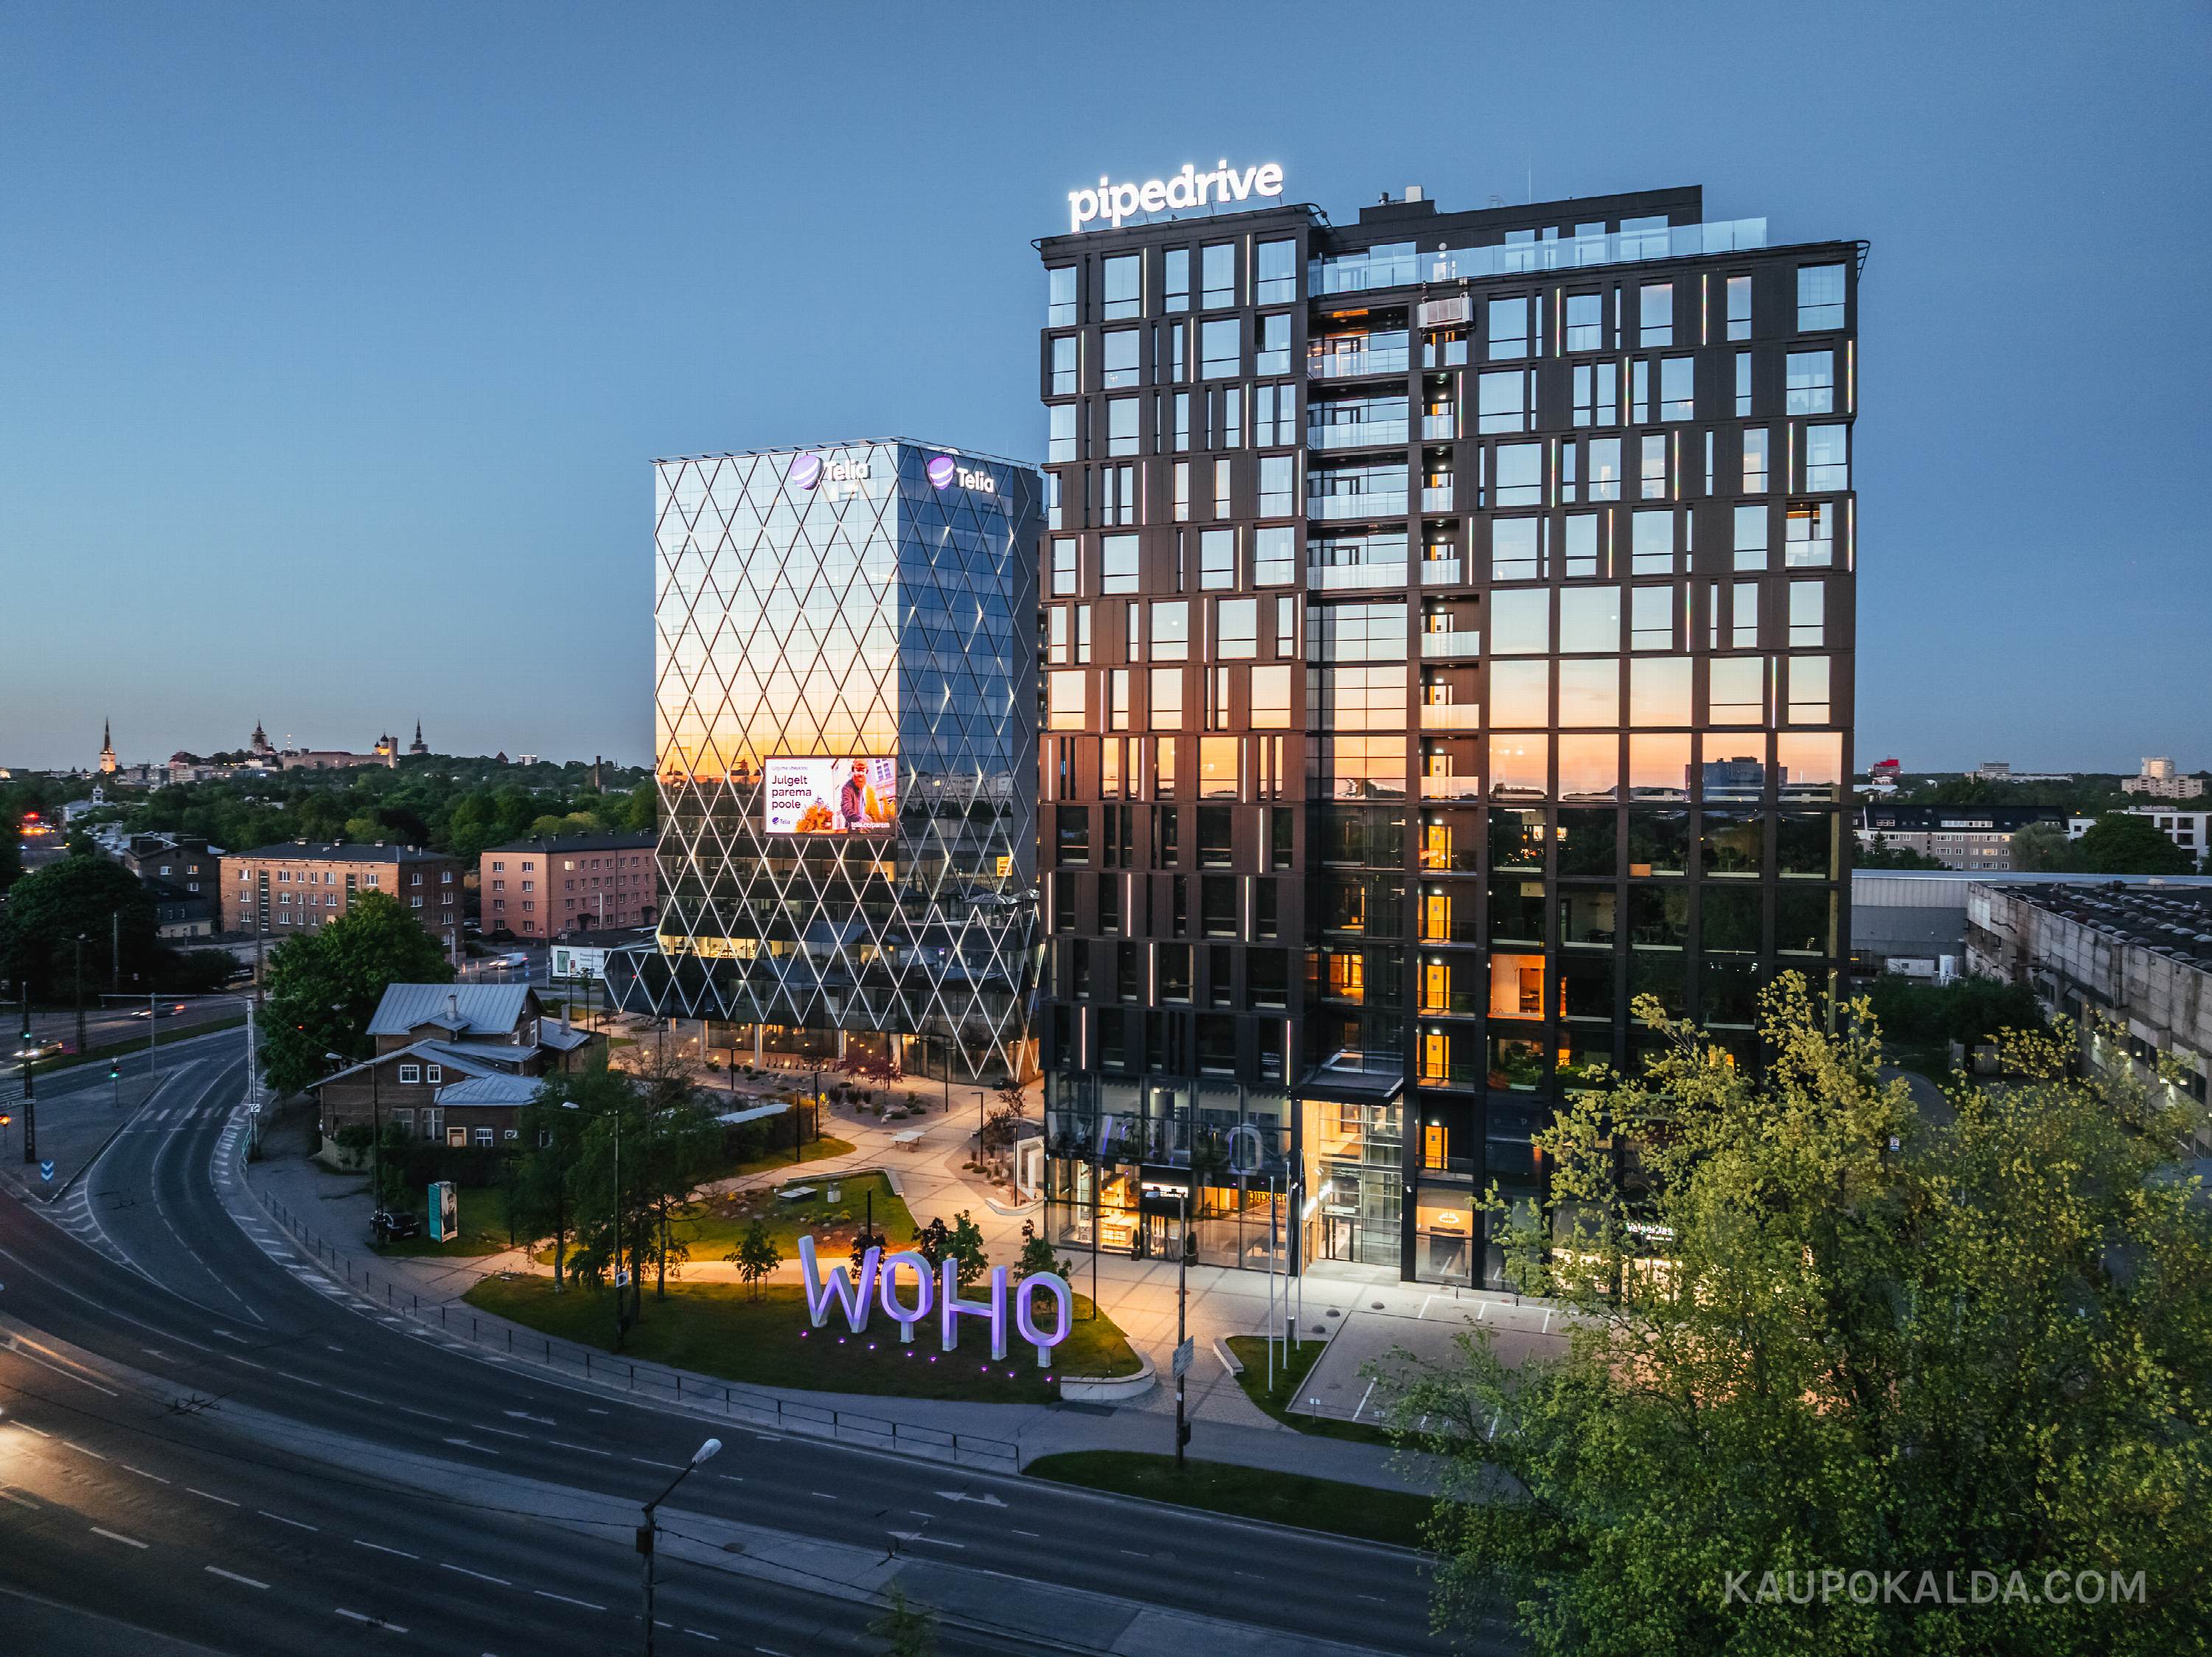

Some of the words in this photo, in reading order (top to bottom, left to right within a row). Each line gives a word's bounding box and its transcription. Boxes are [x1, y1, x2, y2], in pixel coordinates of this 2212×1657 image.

[1068, 159, 1284, 233] pipedrive
[826, 460, 871, 481] Telia
[956, 468, 995, 493] Telia
[771, 775, 808, 787] Julgelt
[771, 789, 812, 799] parema
[771, 799, 801, 810] poole
